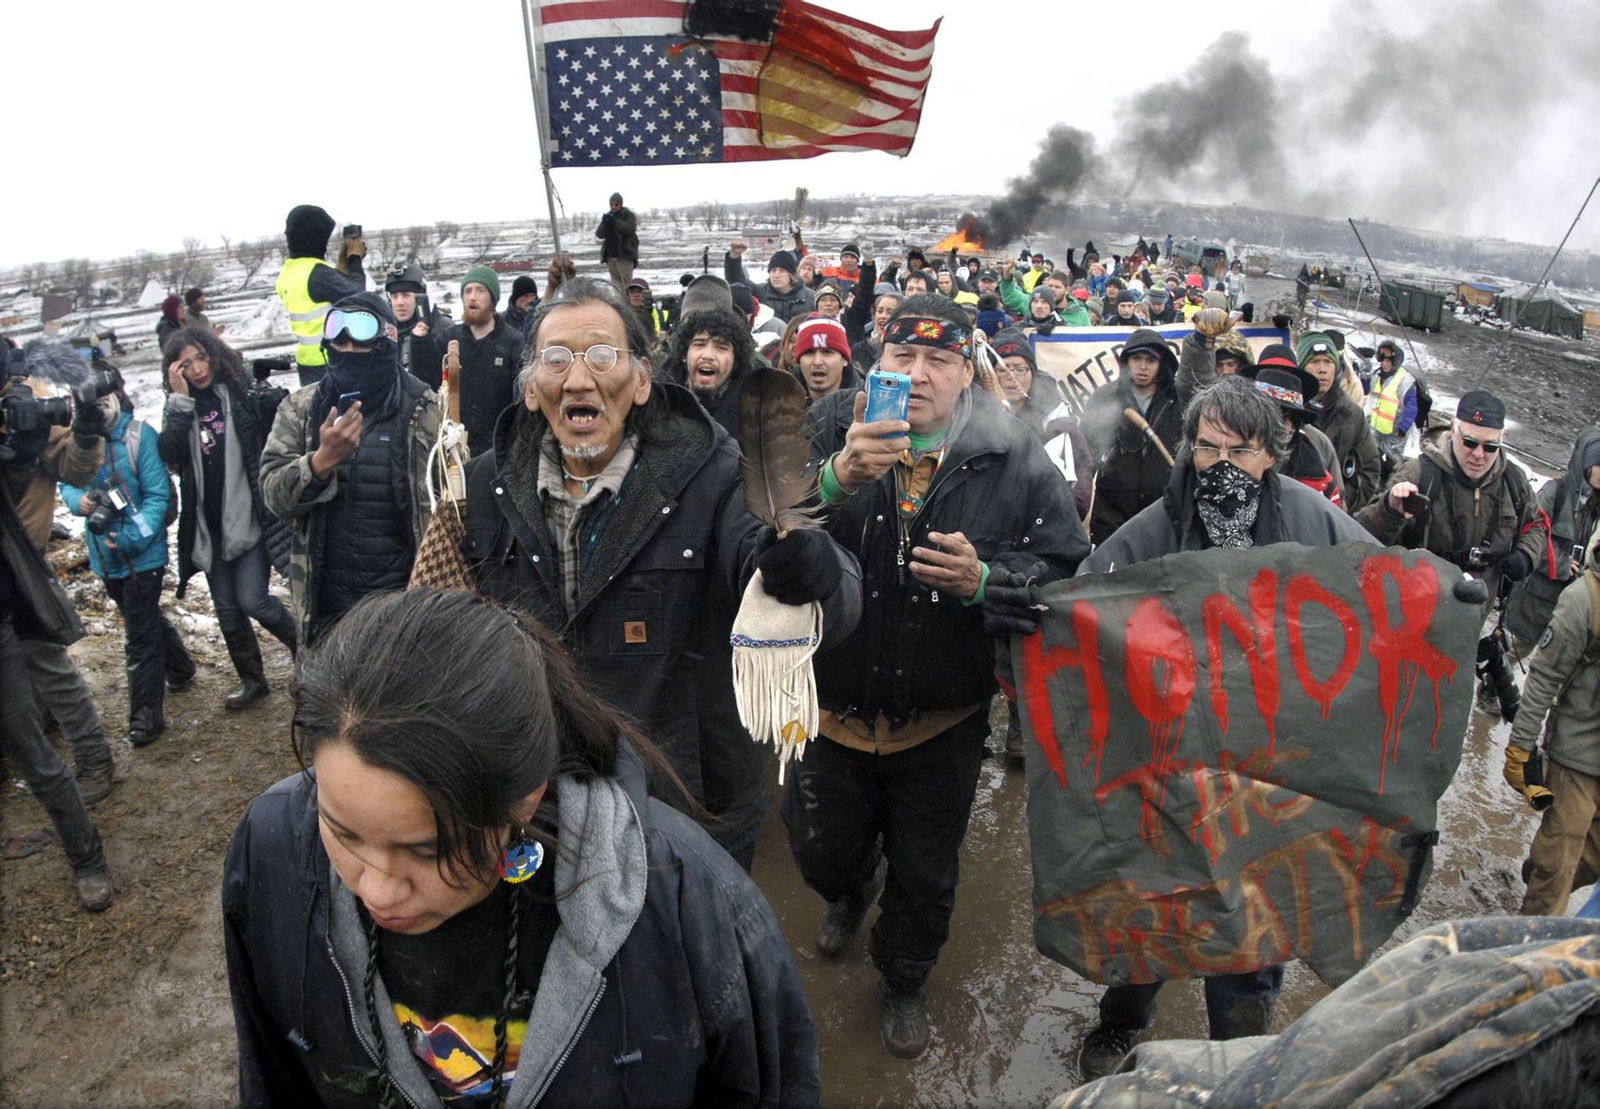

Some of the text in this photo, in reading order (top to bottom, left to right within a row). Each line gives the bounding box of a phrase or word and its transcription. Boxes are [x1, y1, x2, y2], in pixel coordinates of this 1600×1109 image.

[812, 333, 828, 348] N
[1021, 554, 1457, 789] HONOR
[1095, 747, 1314, 868] THE
